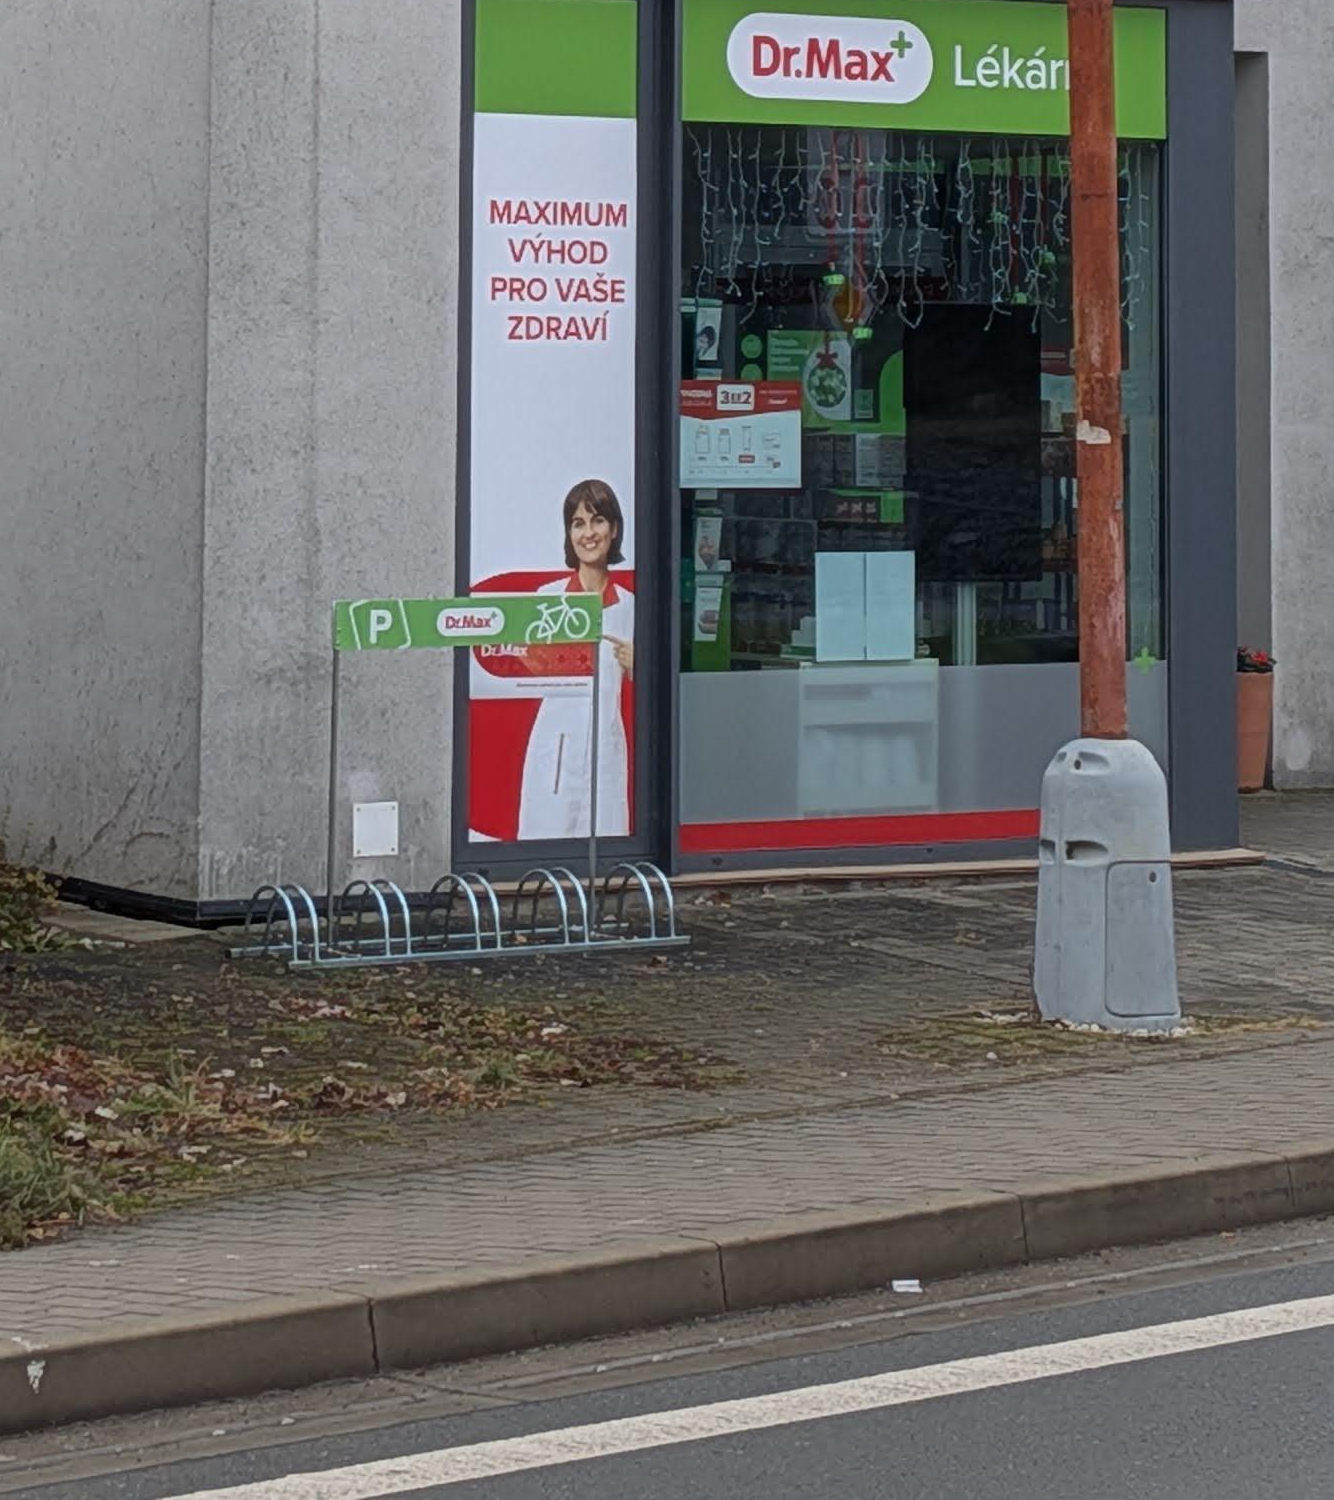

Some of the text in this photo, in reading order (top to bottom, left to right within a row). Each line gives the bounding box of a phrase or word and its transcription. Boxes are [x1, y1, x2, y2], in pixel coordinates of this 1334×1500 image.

[489, 199, 628, 228] MAXIMUM
[507, 233, 608, 265] VÝHOD
[490, 273, 626, 303] PRO VAŠE
[507, 310, 610, 341] ZDRAVÍ
[369, 609, 393, 645] P
